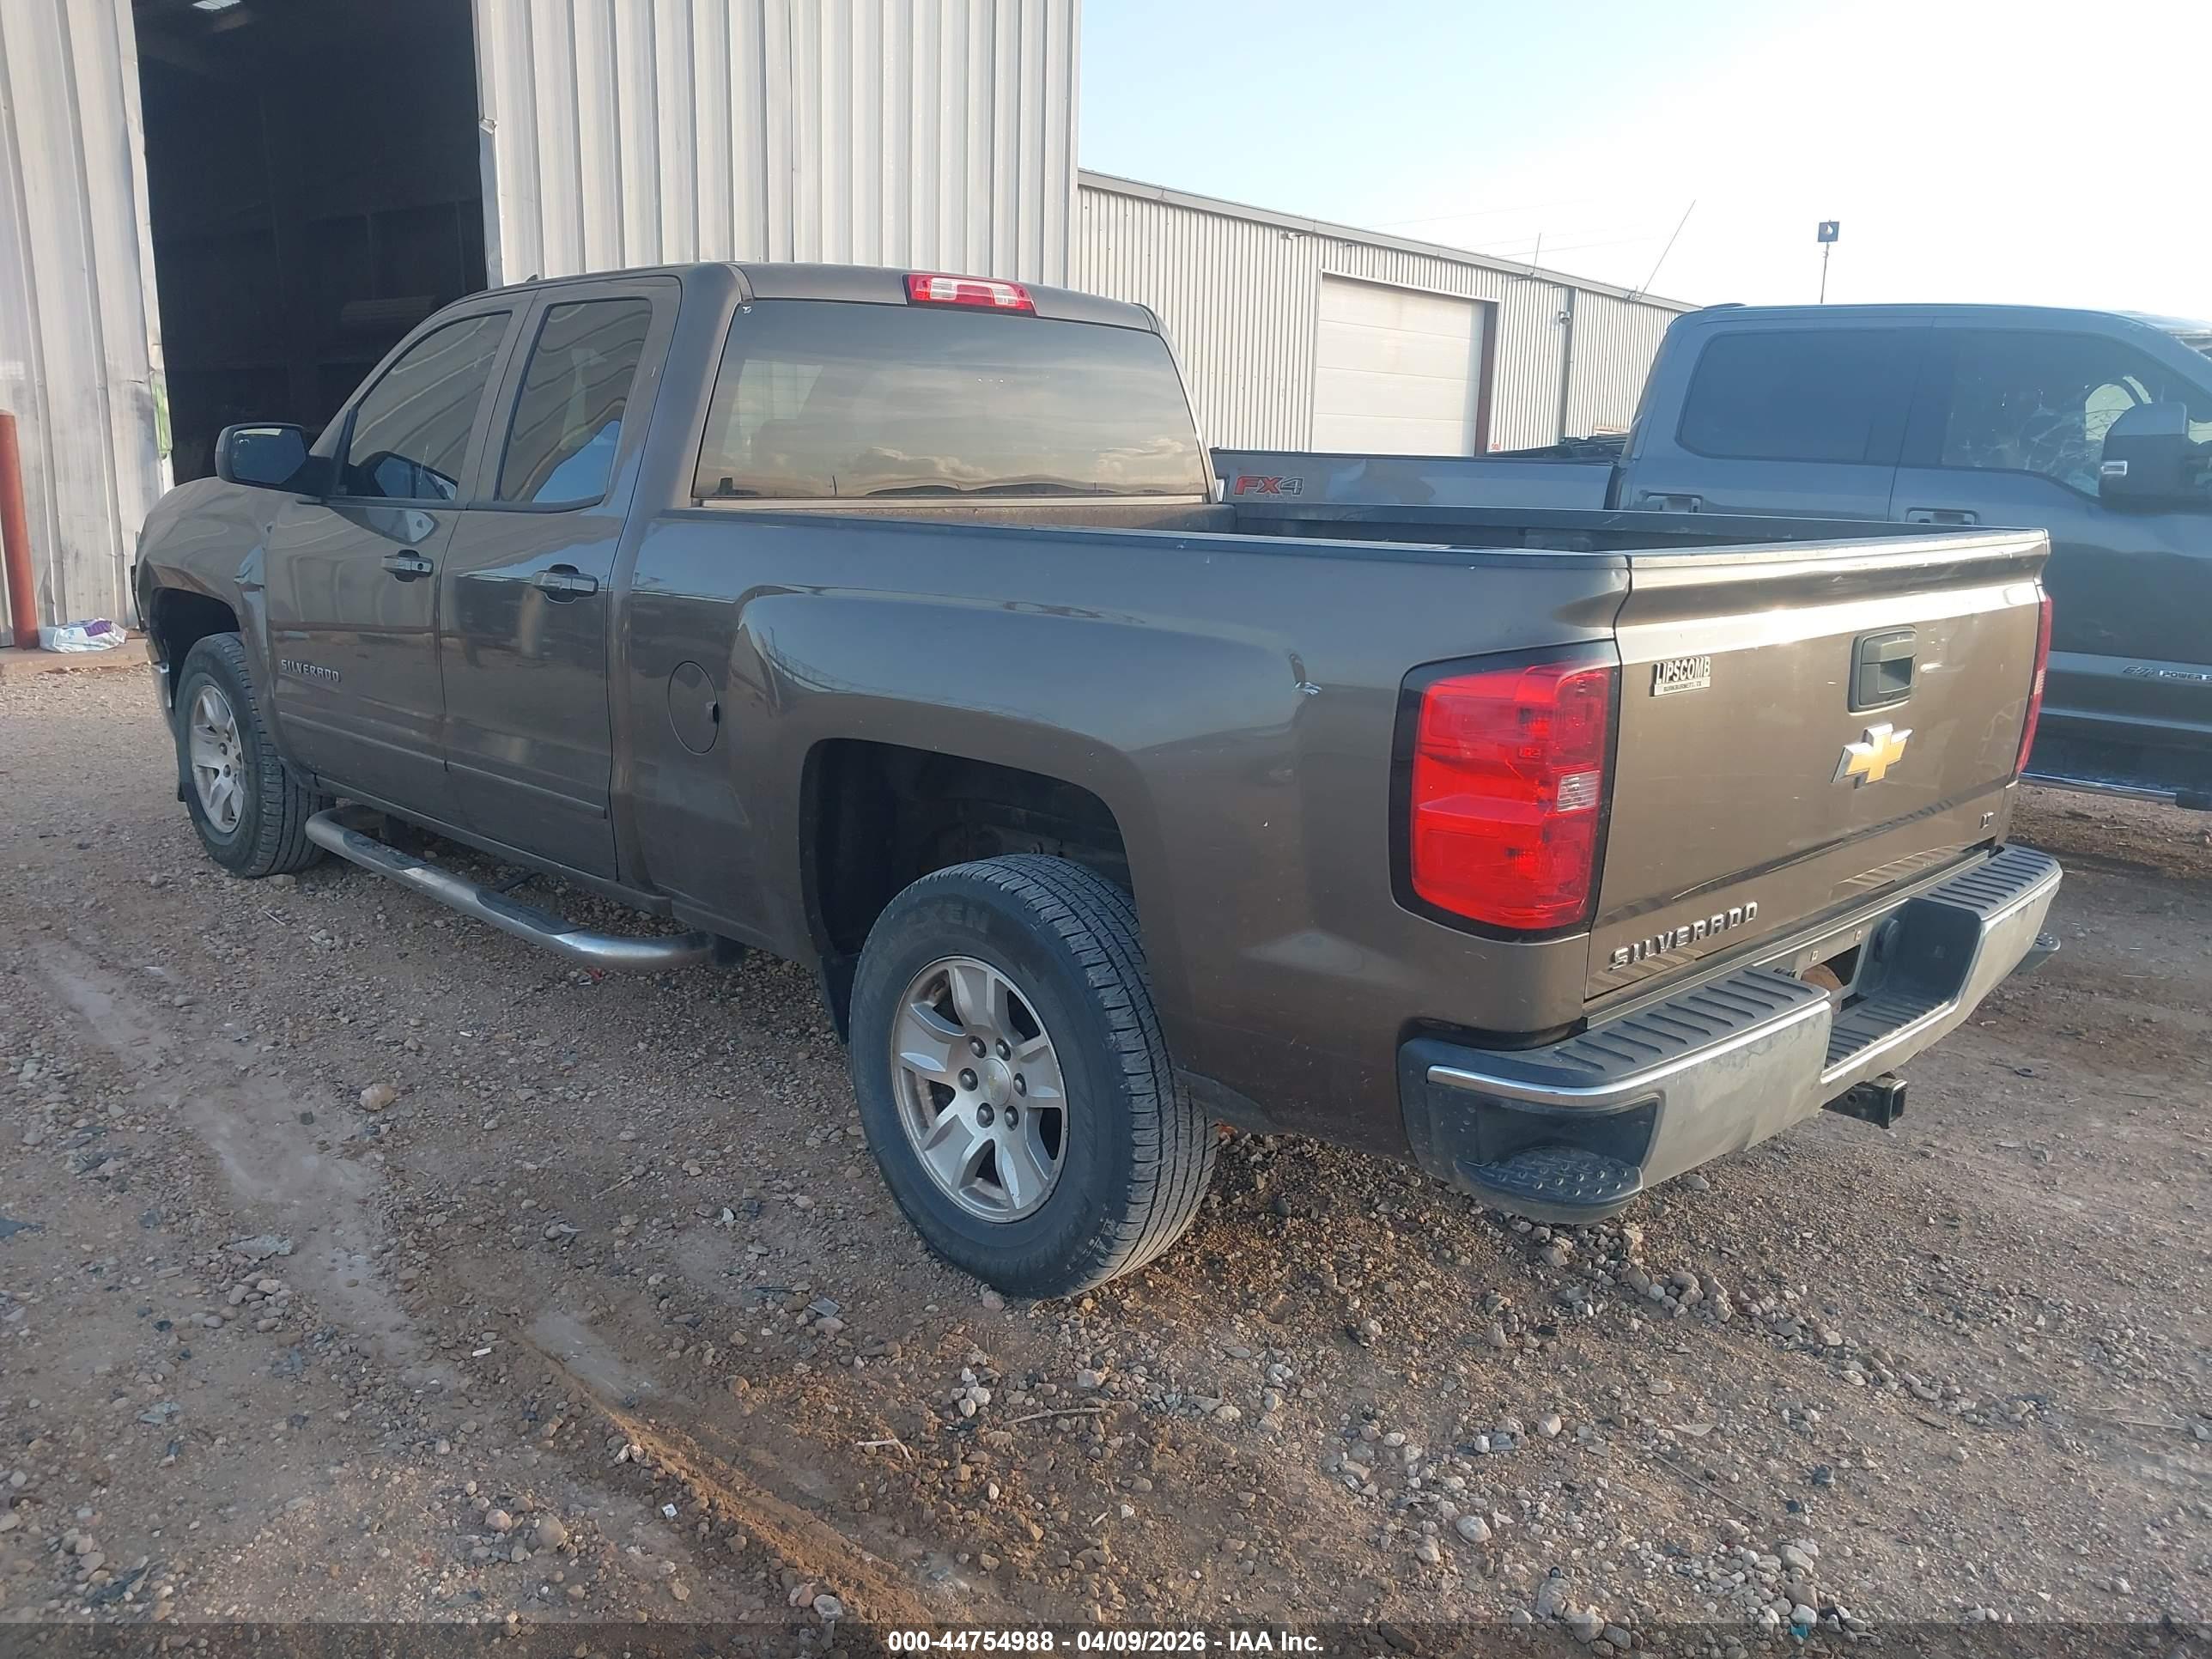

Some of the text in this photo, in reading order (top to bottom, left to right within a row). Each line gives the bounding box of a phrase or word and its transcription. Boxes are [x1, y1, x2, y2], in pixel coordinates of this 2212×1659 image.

[1234, 475, 1304, 495] FX4
[281, 659, 341, 682] SILVERADO
[1654, 656, 1711, 685] LIPSCOMB
[2163, 670, 2203, 680] POWER
[1609, 902, 1758, 970] SILVERADO
